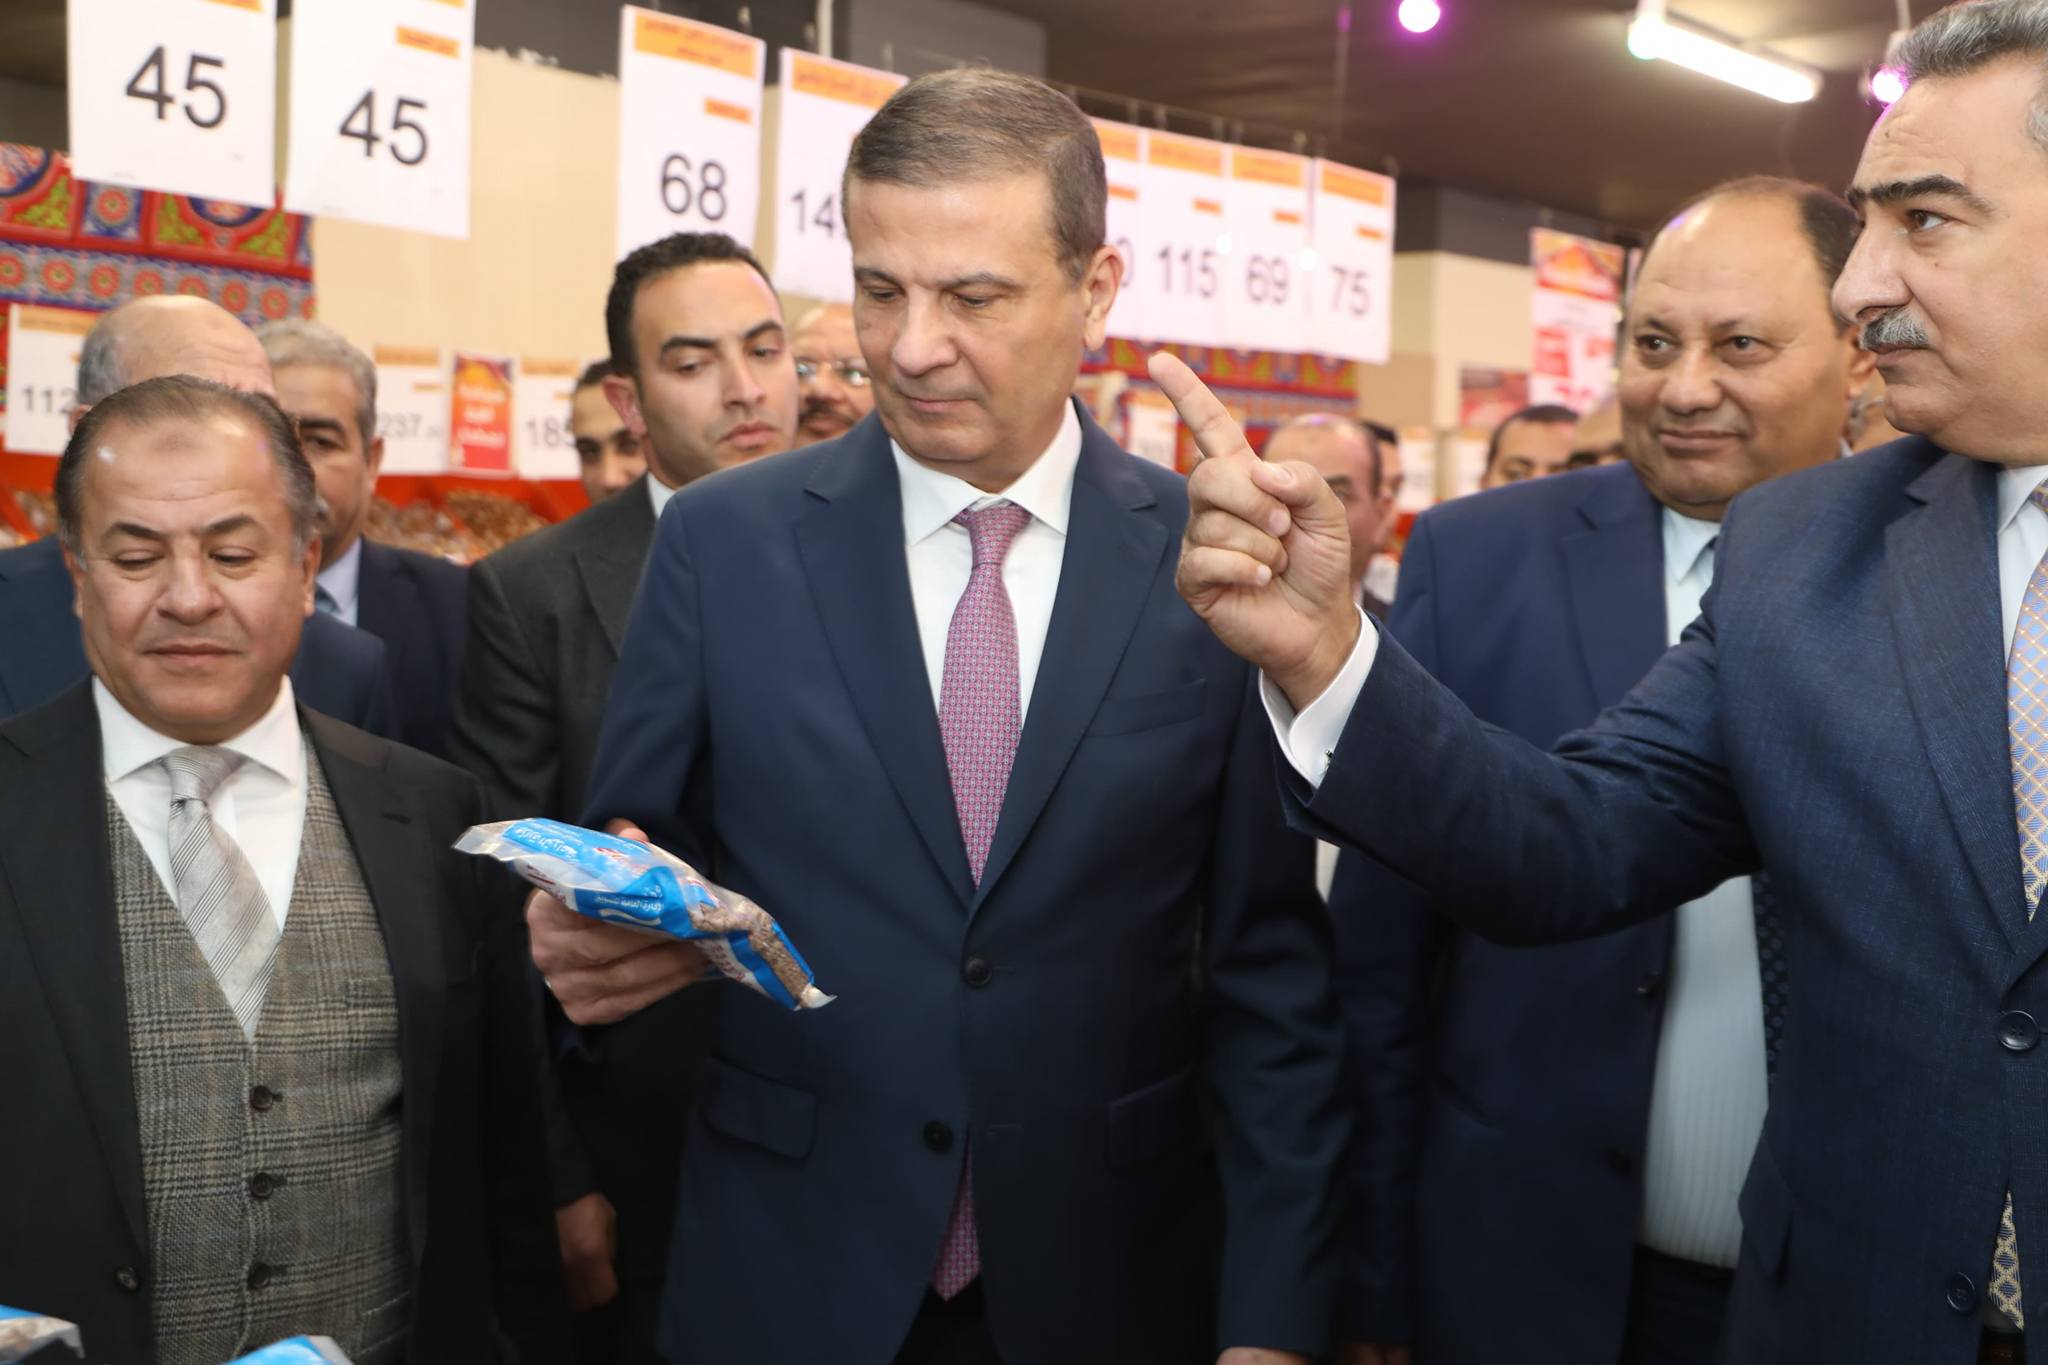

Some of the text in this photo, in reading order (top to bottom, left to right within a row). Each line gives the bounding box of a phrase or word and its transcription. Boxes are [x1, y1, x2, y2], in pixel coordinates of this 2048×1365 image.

[125, 45, 226, 128] 45
[338, 88, 429, 166] 45
[660, 152, 727, 222] 68
[791, 187, 848, 242] 14
[1157, 244, 1217, 299] 115
[1246, 254, 1290, 305] 69
[1331, 263, 1371, 317] 75
